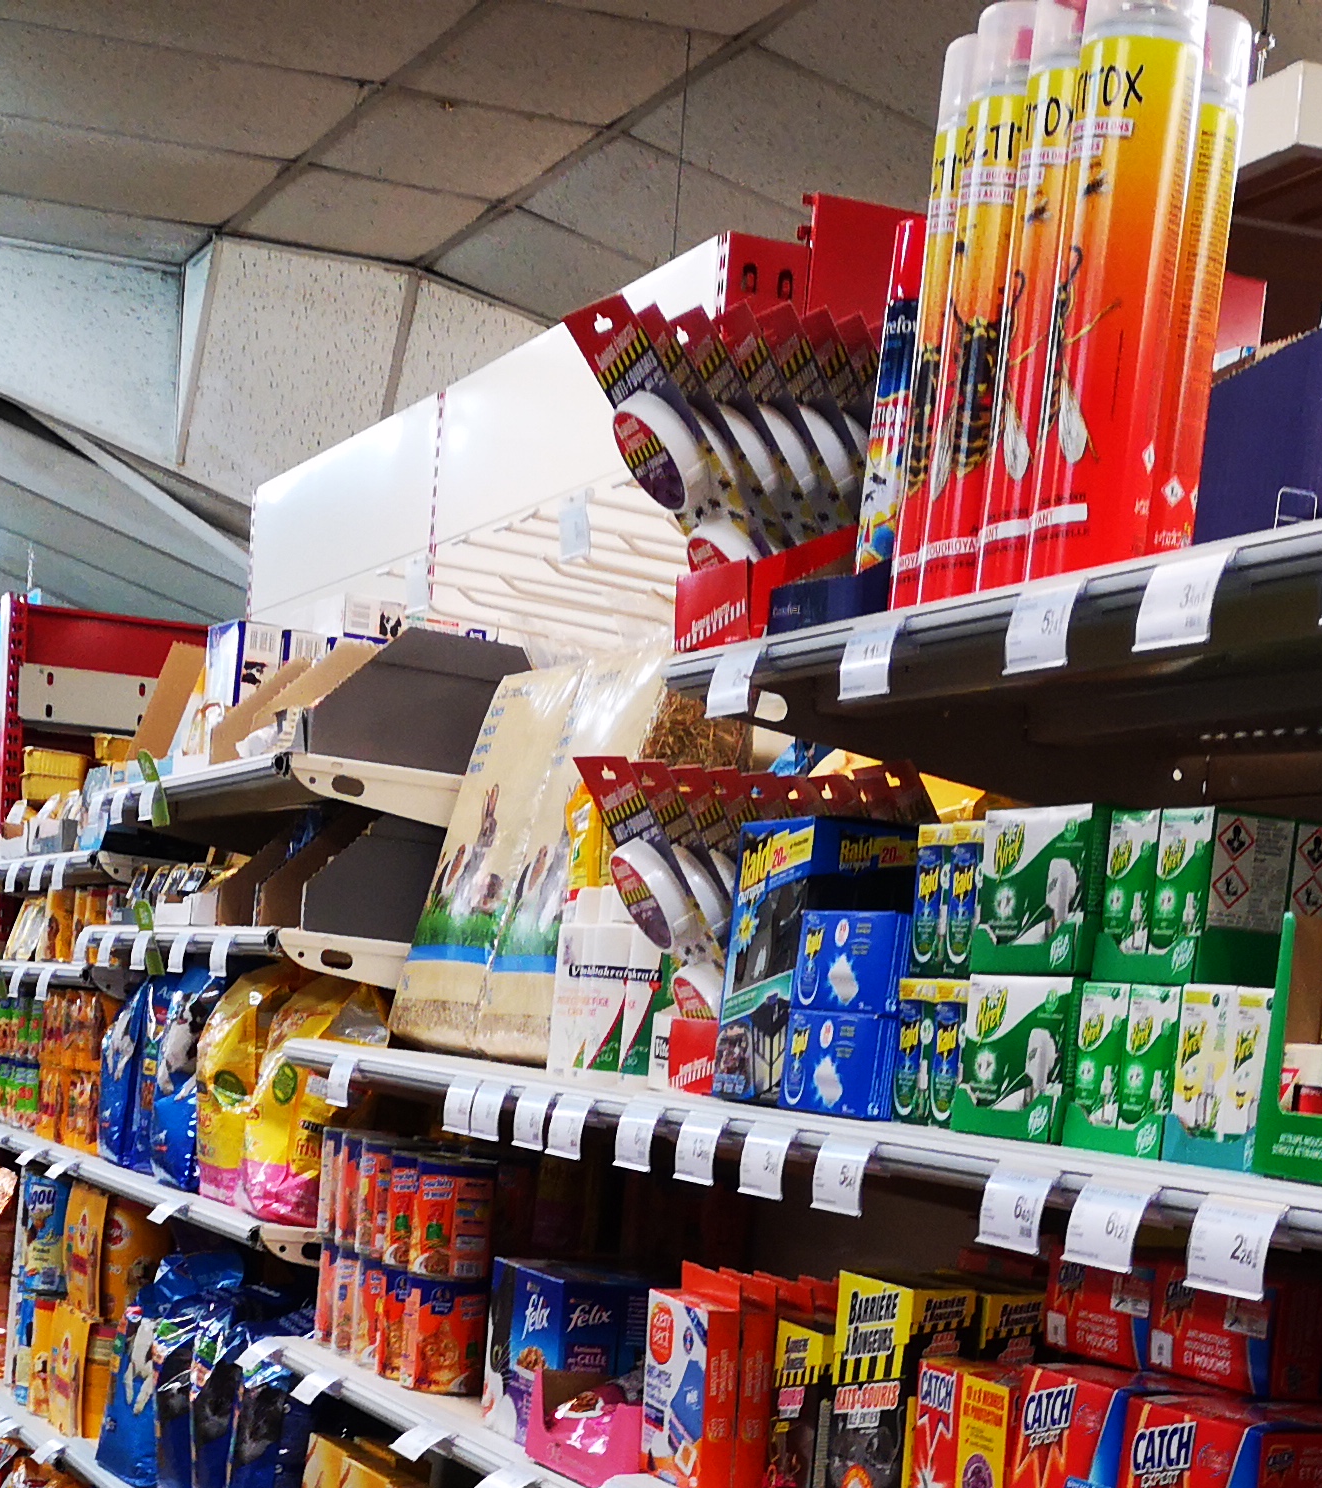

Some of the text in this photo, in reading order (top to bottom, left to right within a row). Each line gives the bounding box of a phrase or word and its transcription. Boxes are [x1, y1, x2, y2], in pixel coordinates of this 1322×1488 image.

[918, 867, 939, 899] Raid
[952, 867, 974, 899] Raid
[935, 1023, 957, 1054] Raid
[521, 1293, 551, 1341] felix
[566, 1302, 612, 1333] felix
[919, 1371, 955, 1409] CATCH
[1024, 1387, 1075, 1432] CATCH
[1132, 1423, 1196, 1474] CATCH
